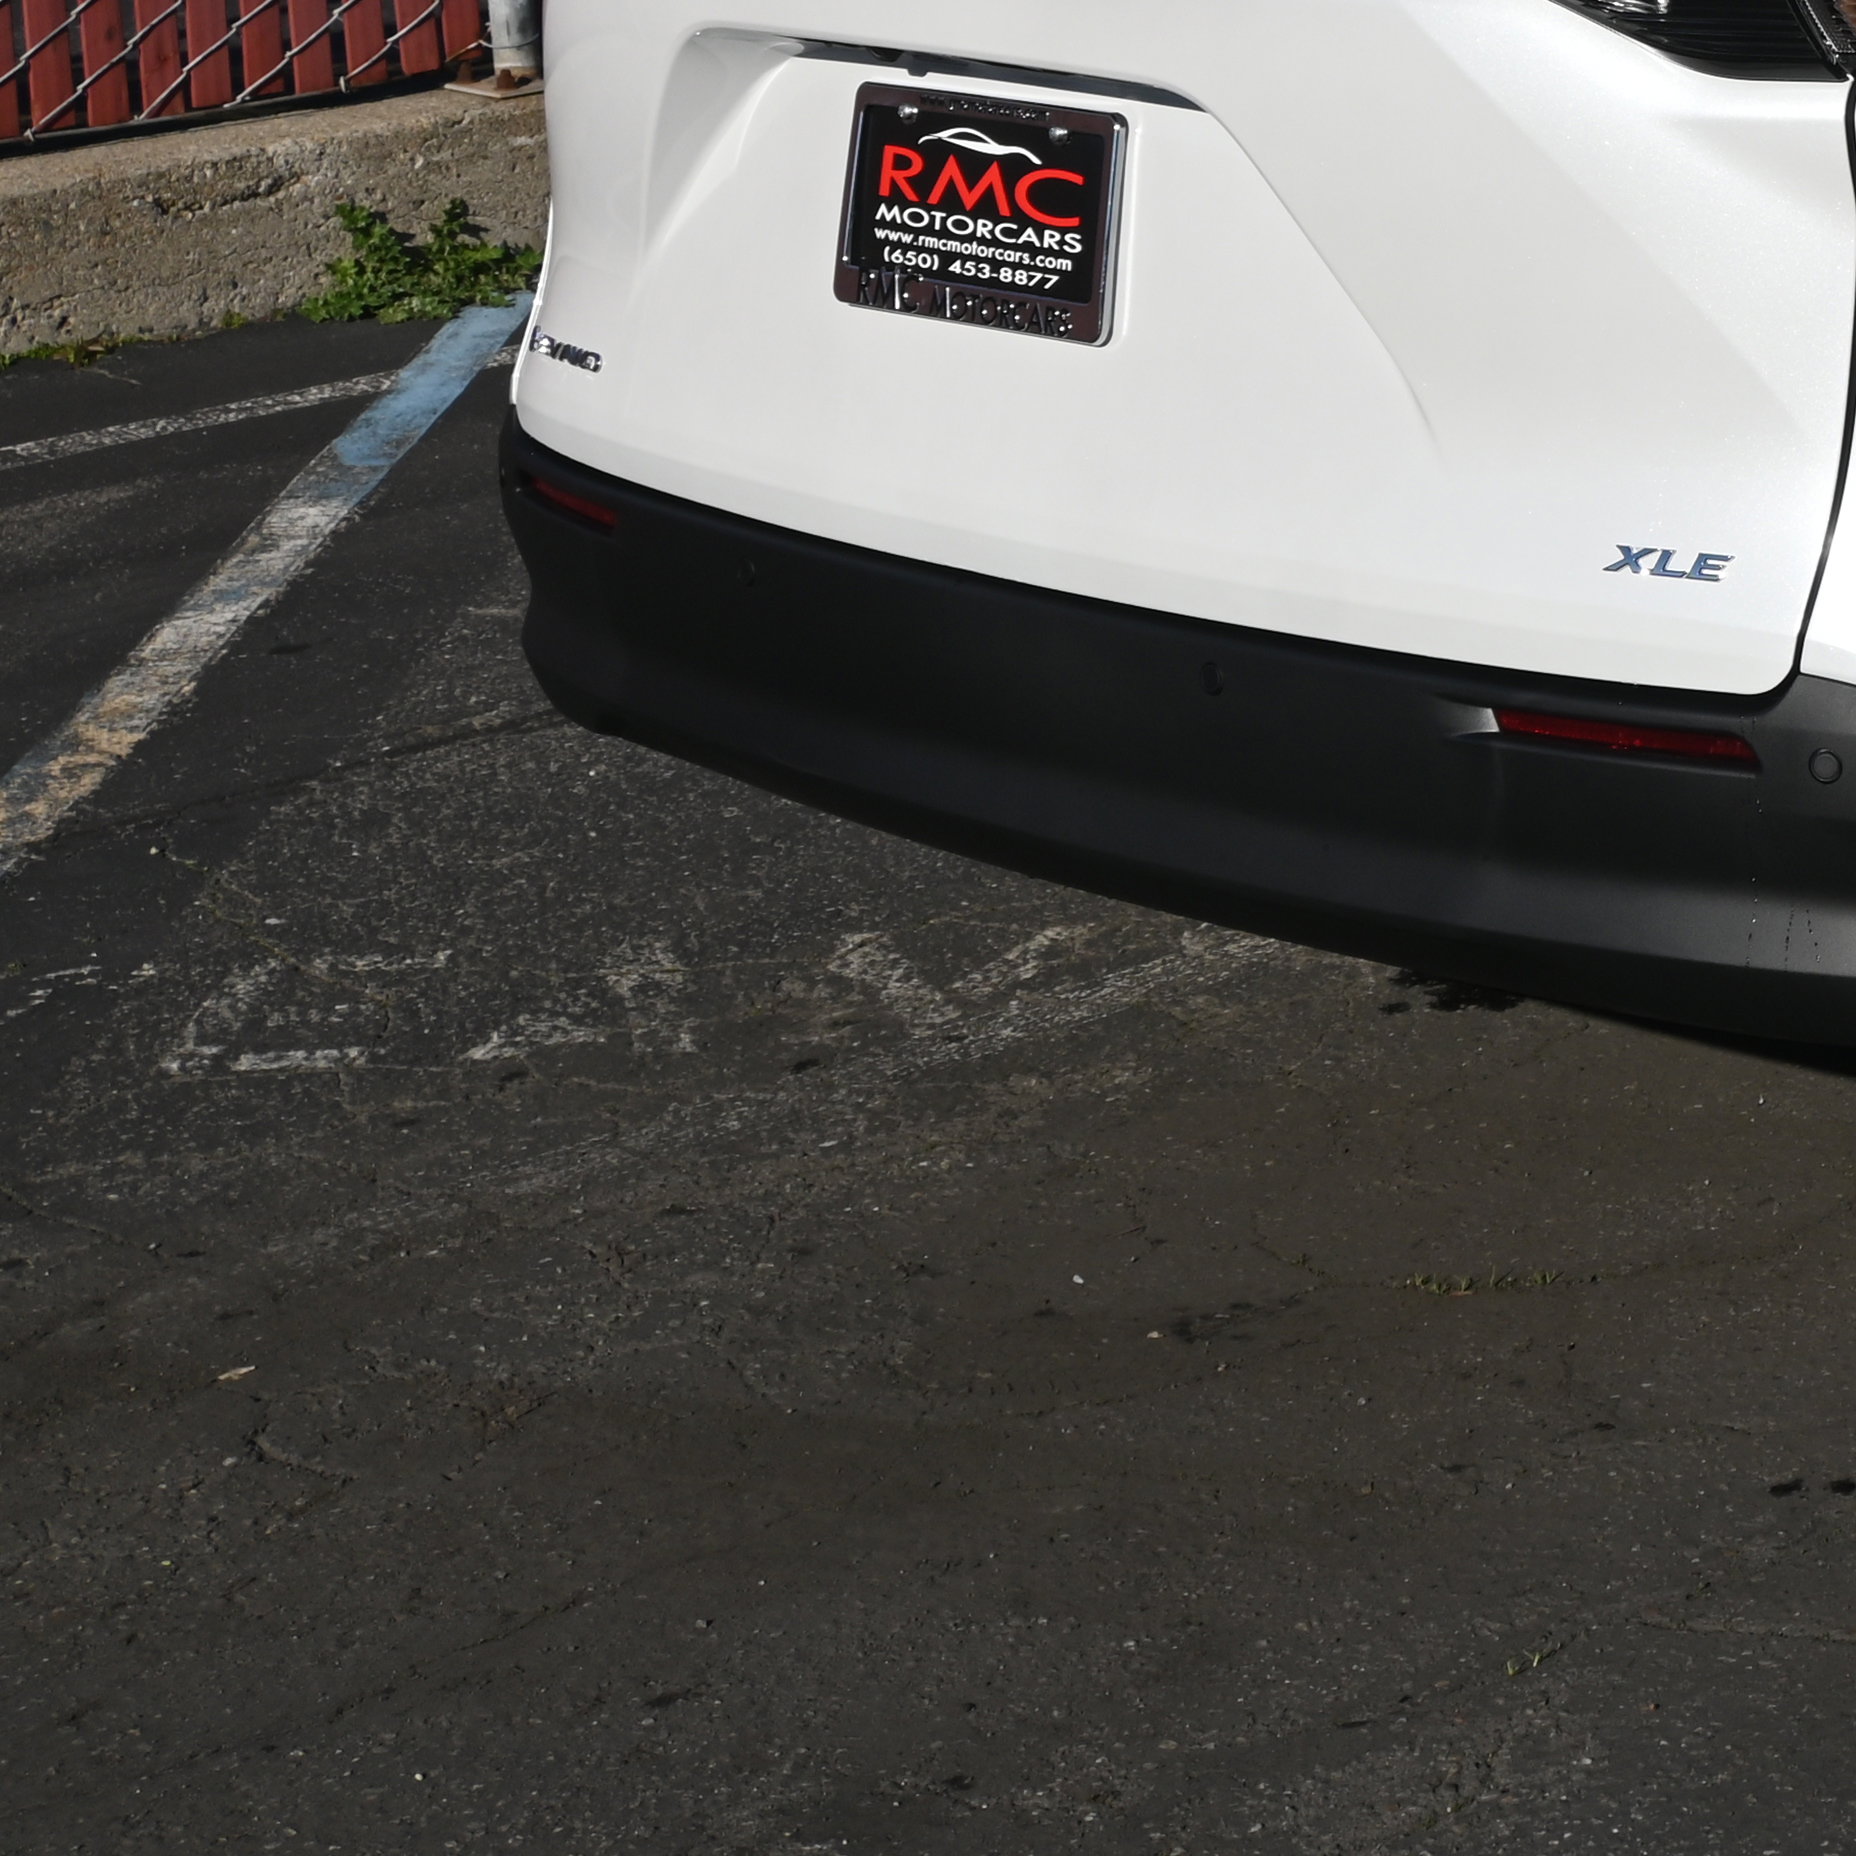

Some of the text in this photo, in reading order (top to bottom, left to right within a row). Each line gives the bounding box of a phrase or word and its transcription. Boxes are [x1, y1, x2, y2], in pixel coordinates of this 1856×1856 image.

[879, 145, 1085, 227] RMC
[874, 227, 1073, 272] www.rmcmotorcars.com
[875, 203, 1083, 253] MOTORCARS
[883, 245, 1060, 290] (650) 453-8877
[857, 266, 1074, 338] RMC MOTORCARS
[1602, 544, 1735, 582] XLE
